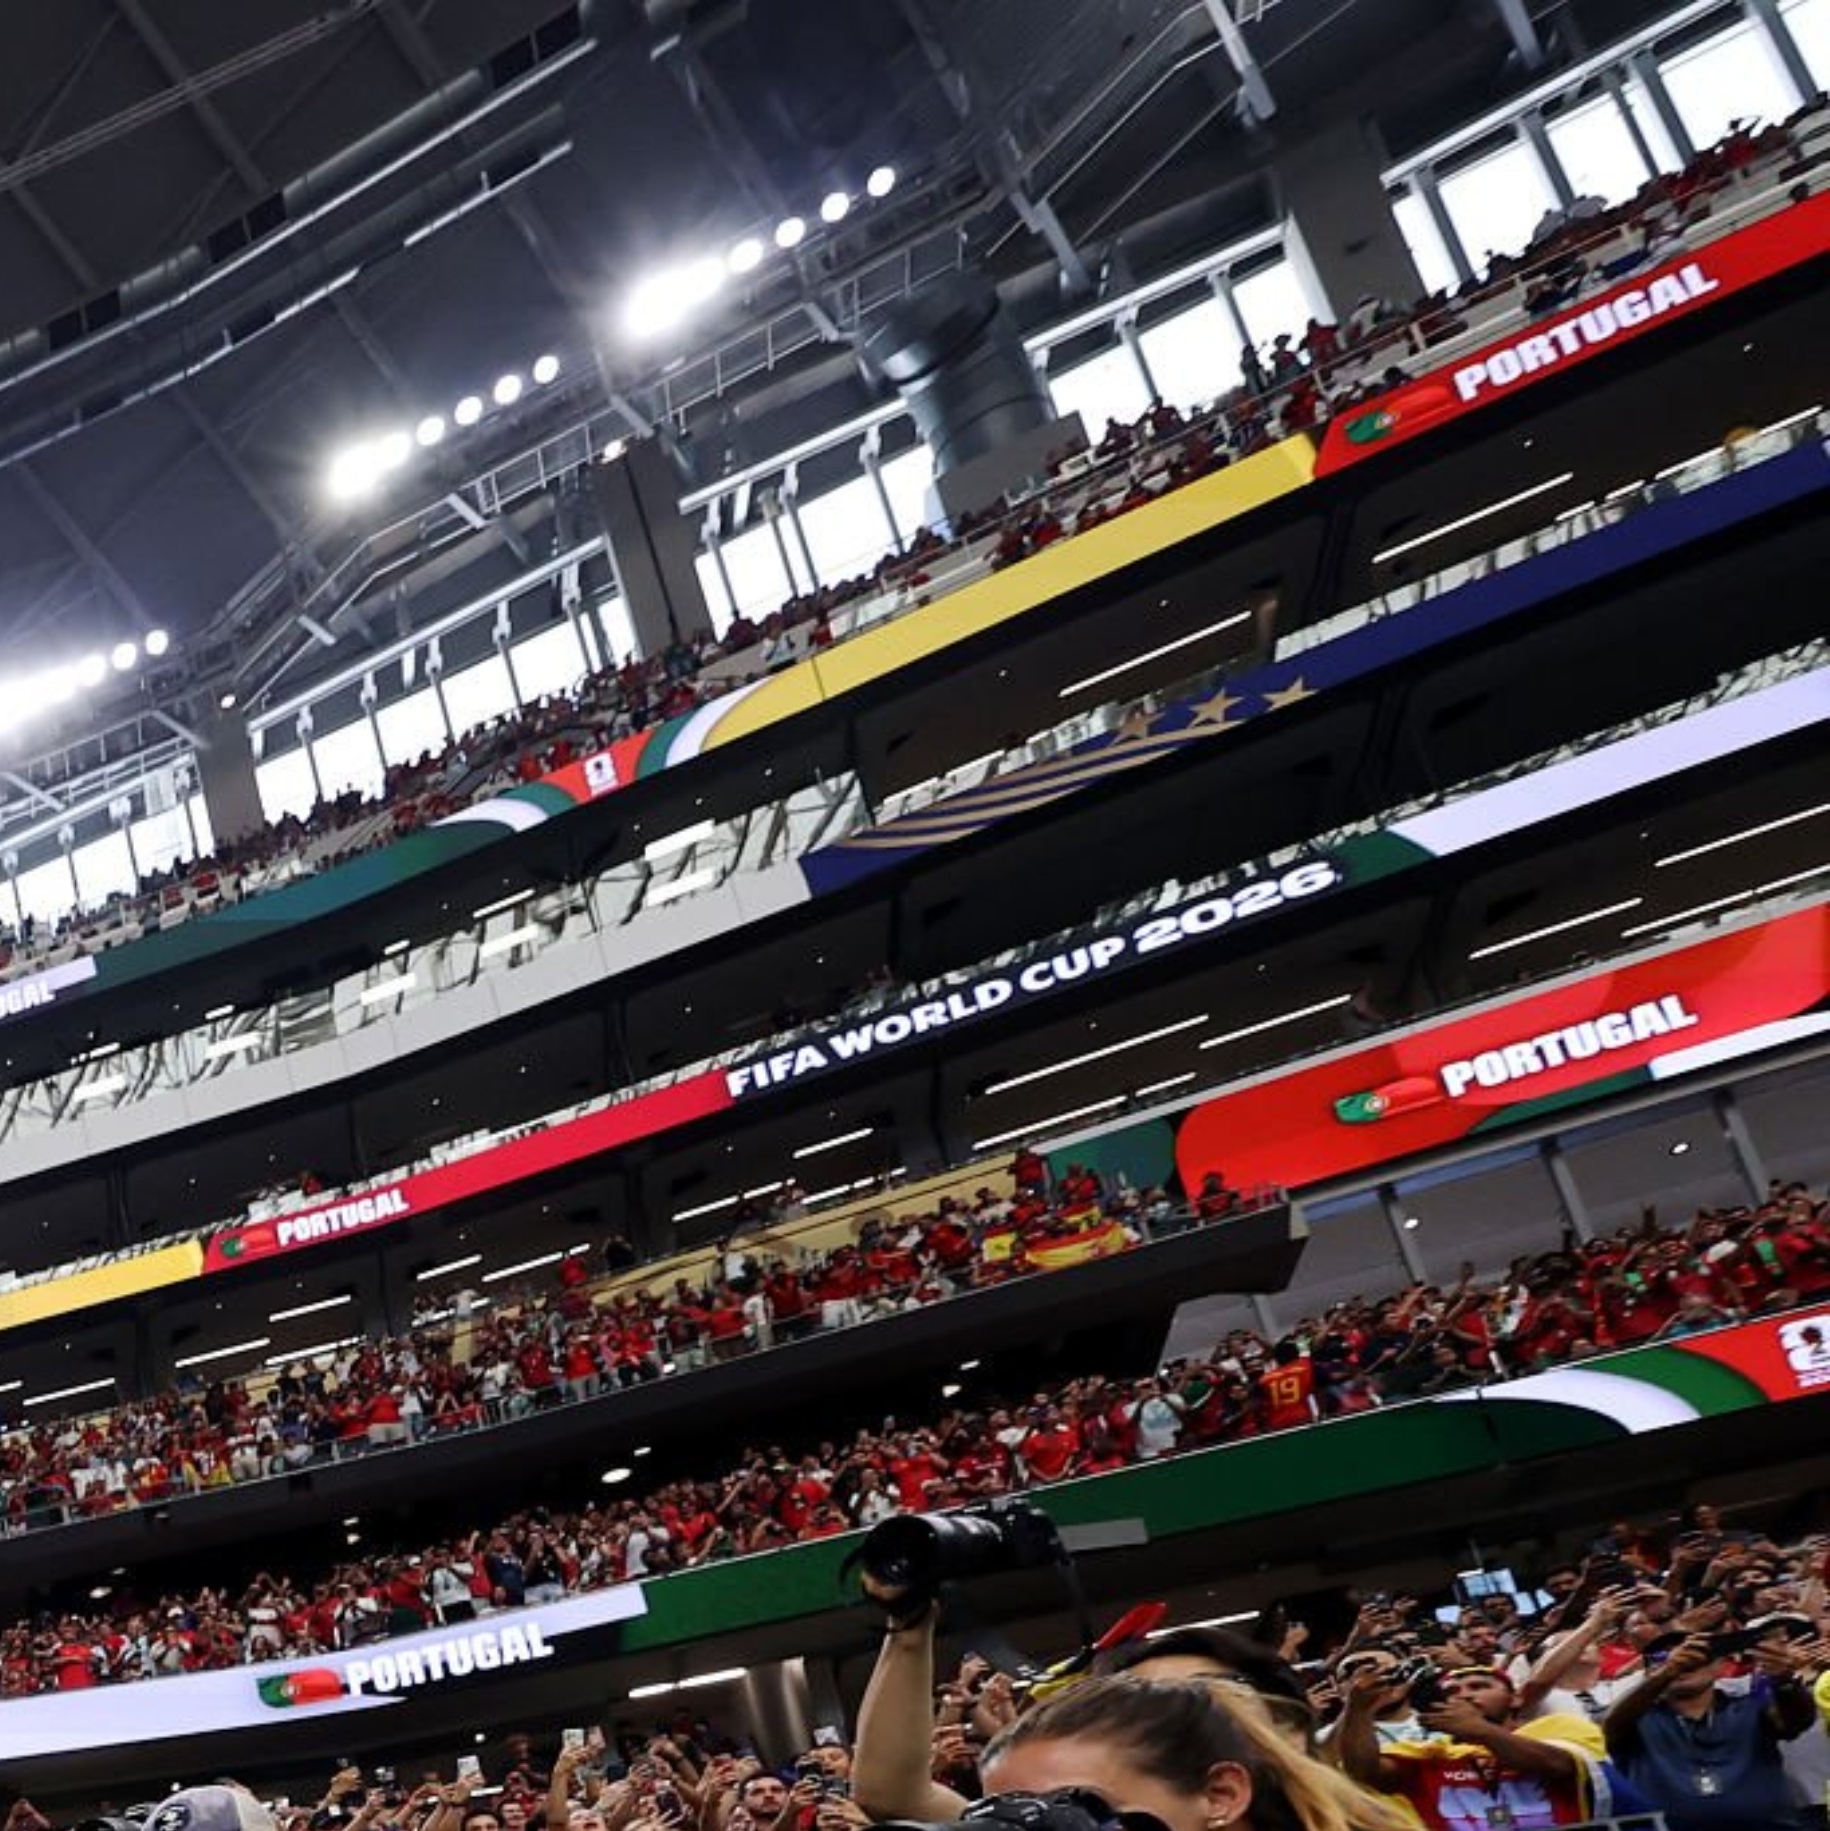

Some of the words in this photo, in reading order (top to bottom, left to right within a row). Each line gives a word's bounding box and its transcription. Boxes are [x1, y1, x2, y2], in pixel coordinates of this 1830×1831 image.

[1454, 263, 1718, 401] PORTUGAL
[727, 1046, 827, 1096] FIFA
[832, 980, 1013, 1061] WORLD
[1021, 937, 1126, 992] CUP
[1136, 860, 1337, 953] 2026
[1442, 996, 1697, 1098] PORTUGAL
[277, 1189, 408, 1245] PORTUGAL
[1270, 1378, 1300, 1410] 19
[344, 1622, 554, 1697] PORTUGAL
